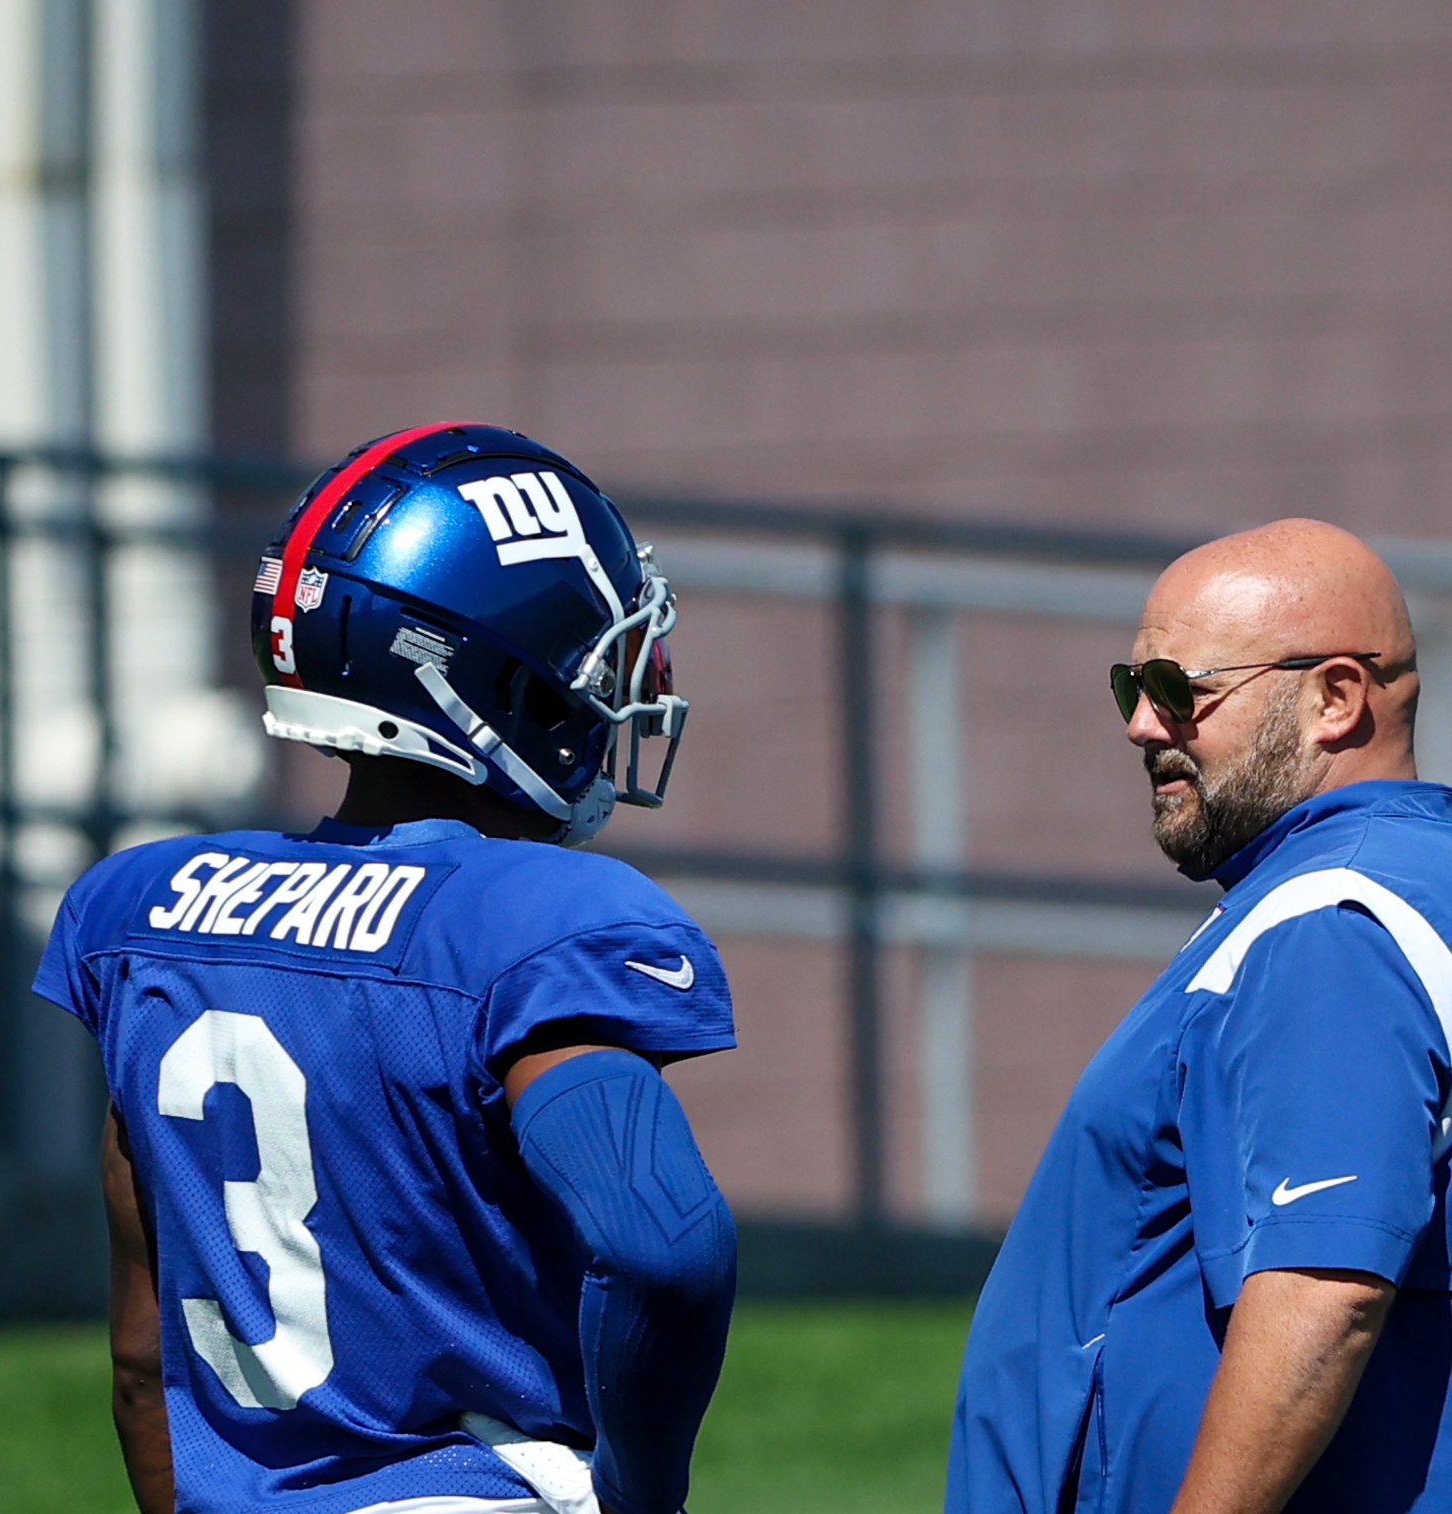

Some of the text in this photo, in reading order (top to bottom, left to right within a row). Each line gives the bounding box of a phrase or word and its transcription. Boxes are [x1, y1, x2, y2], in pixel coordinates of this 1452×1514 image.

[298, 585, 319, 604] NFL
[270, 615, 296, 674] 3
[149, 851, 426, 953] SHEPARD
[157, 1009, 334, 1410] 3
